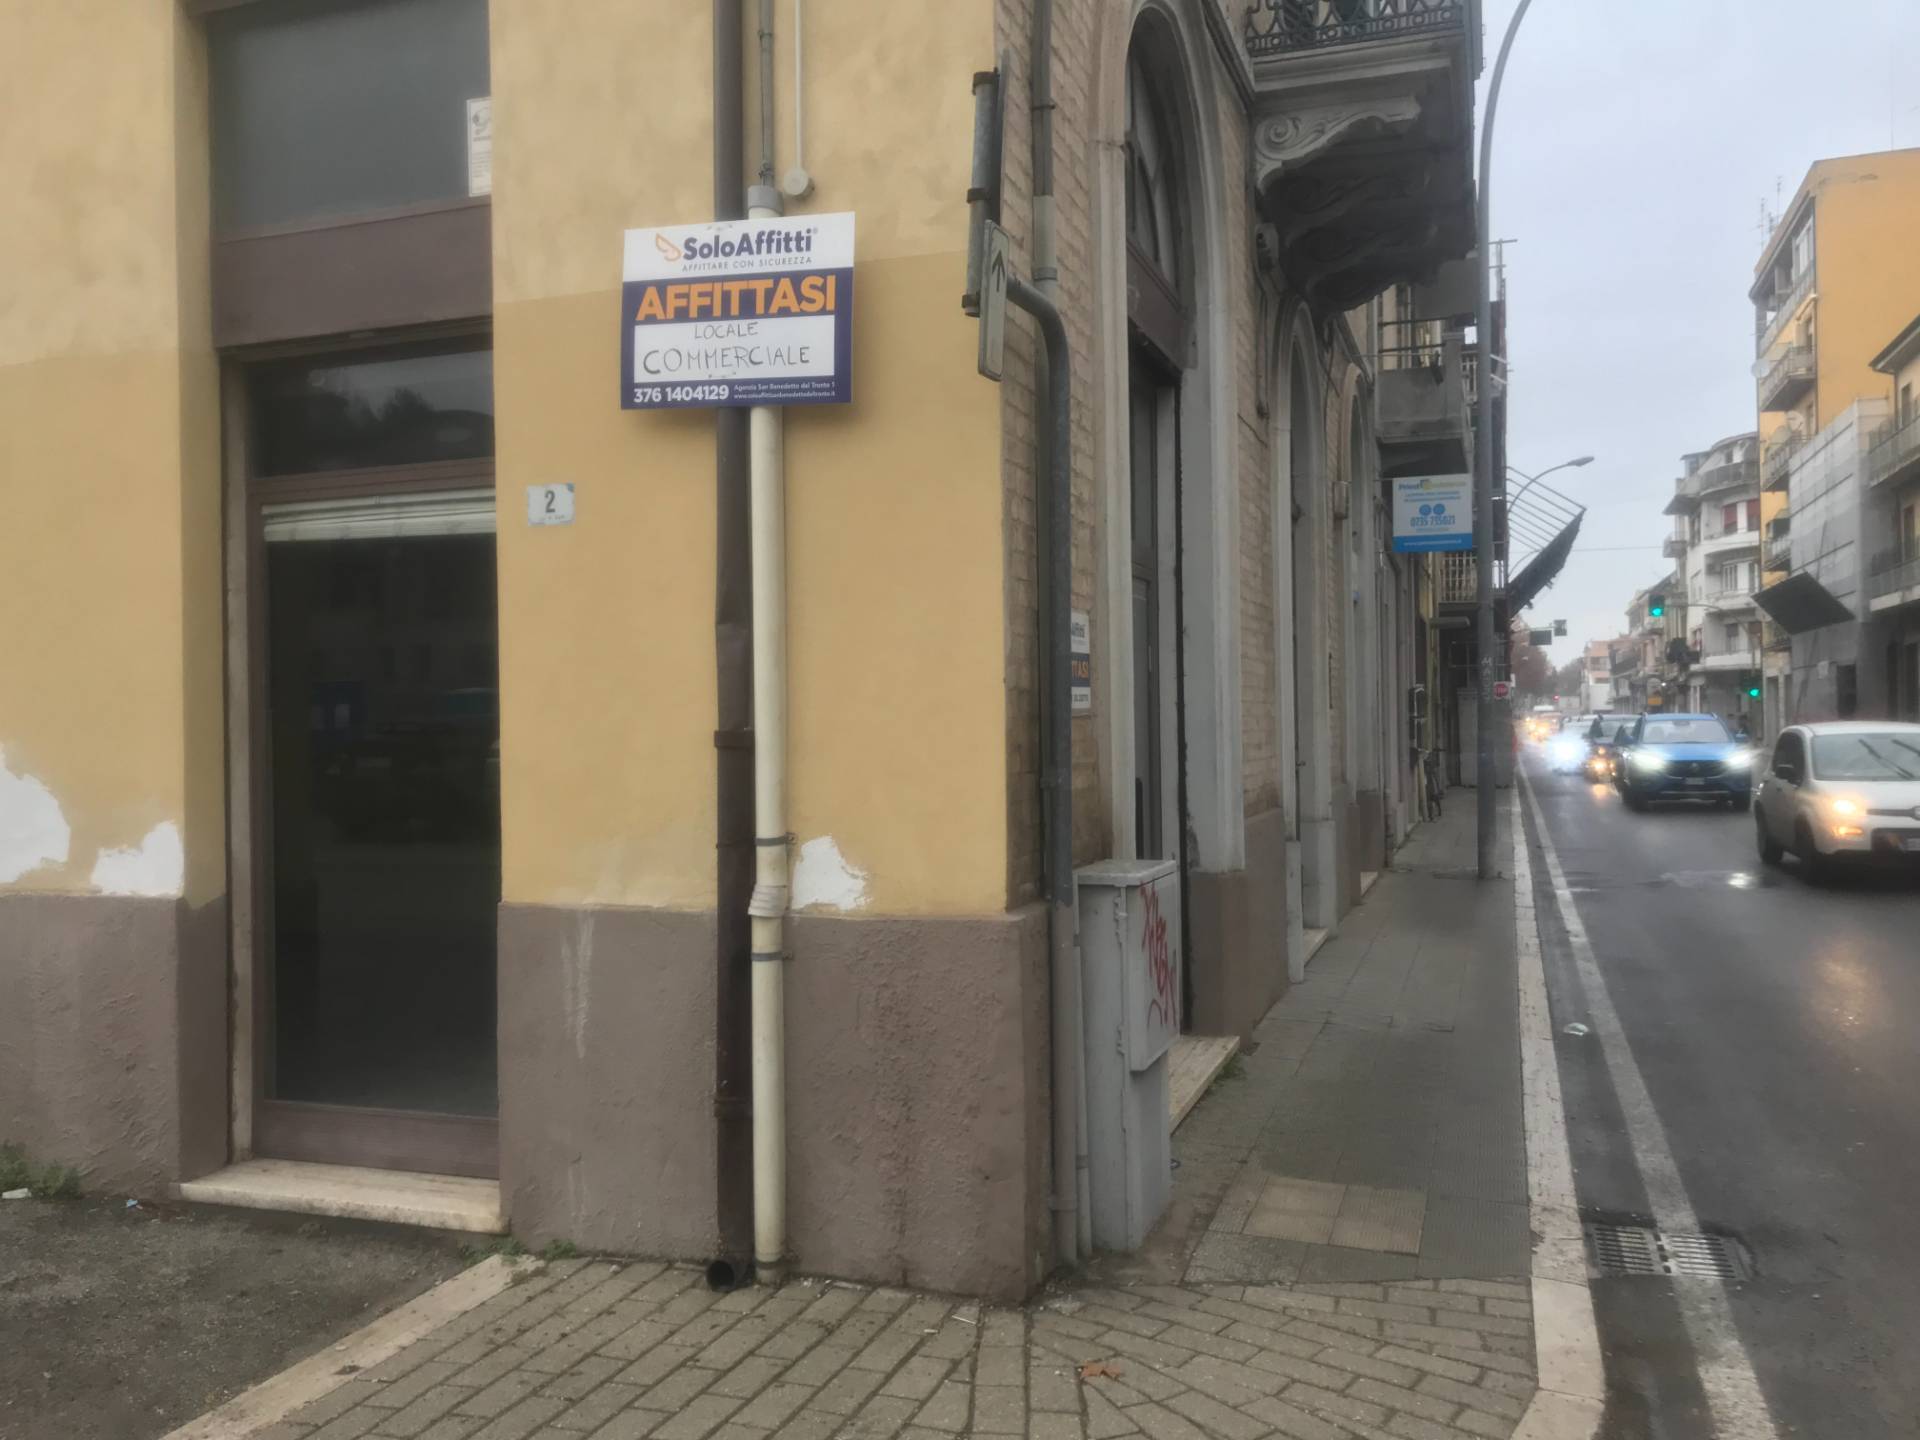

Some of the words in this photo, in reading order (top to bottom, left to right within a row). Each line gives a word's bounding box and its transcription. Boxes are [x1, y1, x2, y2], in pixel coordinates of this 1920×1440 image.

[683, 229, 812, 260] SoloAffitti
[682, 262, 729, 272] AFFITTARE
[733, 260, 754, 269] CON
[759, 256, 812, 267] SICUREZZA
[635, 274, 837, 321] AFFITTASI
[694, 321, 758, 340] LOCALE
[643, 346, 810, 375] COMMERCIALE
[634, 388, 662, 403] 376
[666, 384, 729, 402] 1404129
[545, 490, 556, 513] 2
